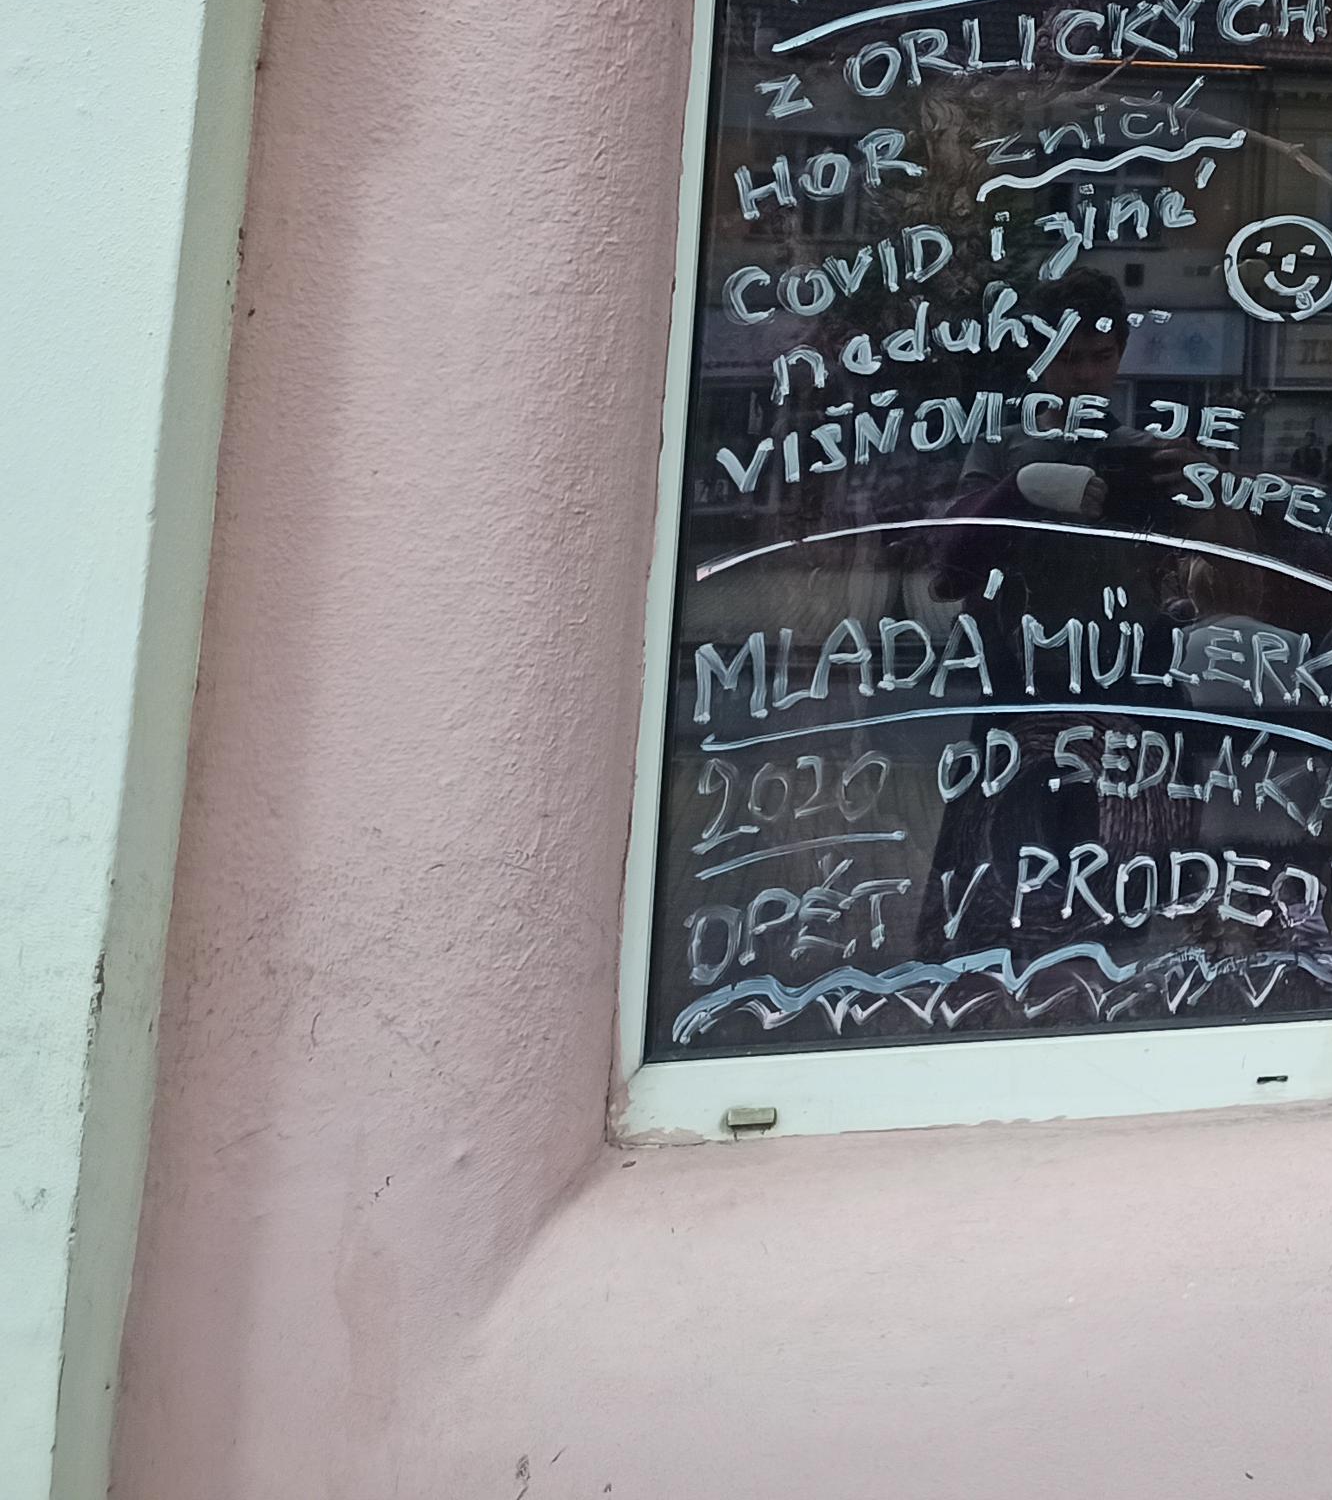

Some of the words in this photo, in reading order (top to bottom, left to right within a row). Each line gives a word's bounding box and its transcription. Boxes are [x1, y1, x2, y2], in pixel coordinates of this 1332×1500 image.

[734, 129, 927, 220] HOR
[722, 224, 954, 326] COVID
[1143, 399, 1247, 452] JE
[694, 567, 1004, 725] MLADÁ
[692, 751, 892, 856] 2020
[938, 727, 1021, 803] OD
[685, 854, 912, 985] OPĚT
[941, 863, 990, 940] V
